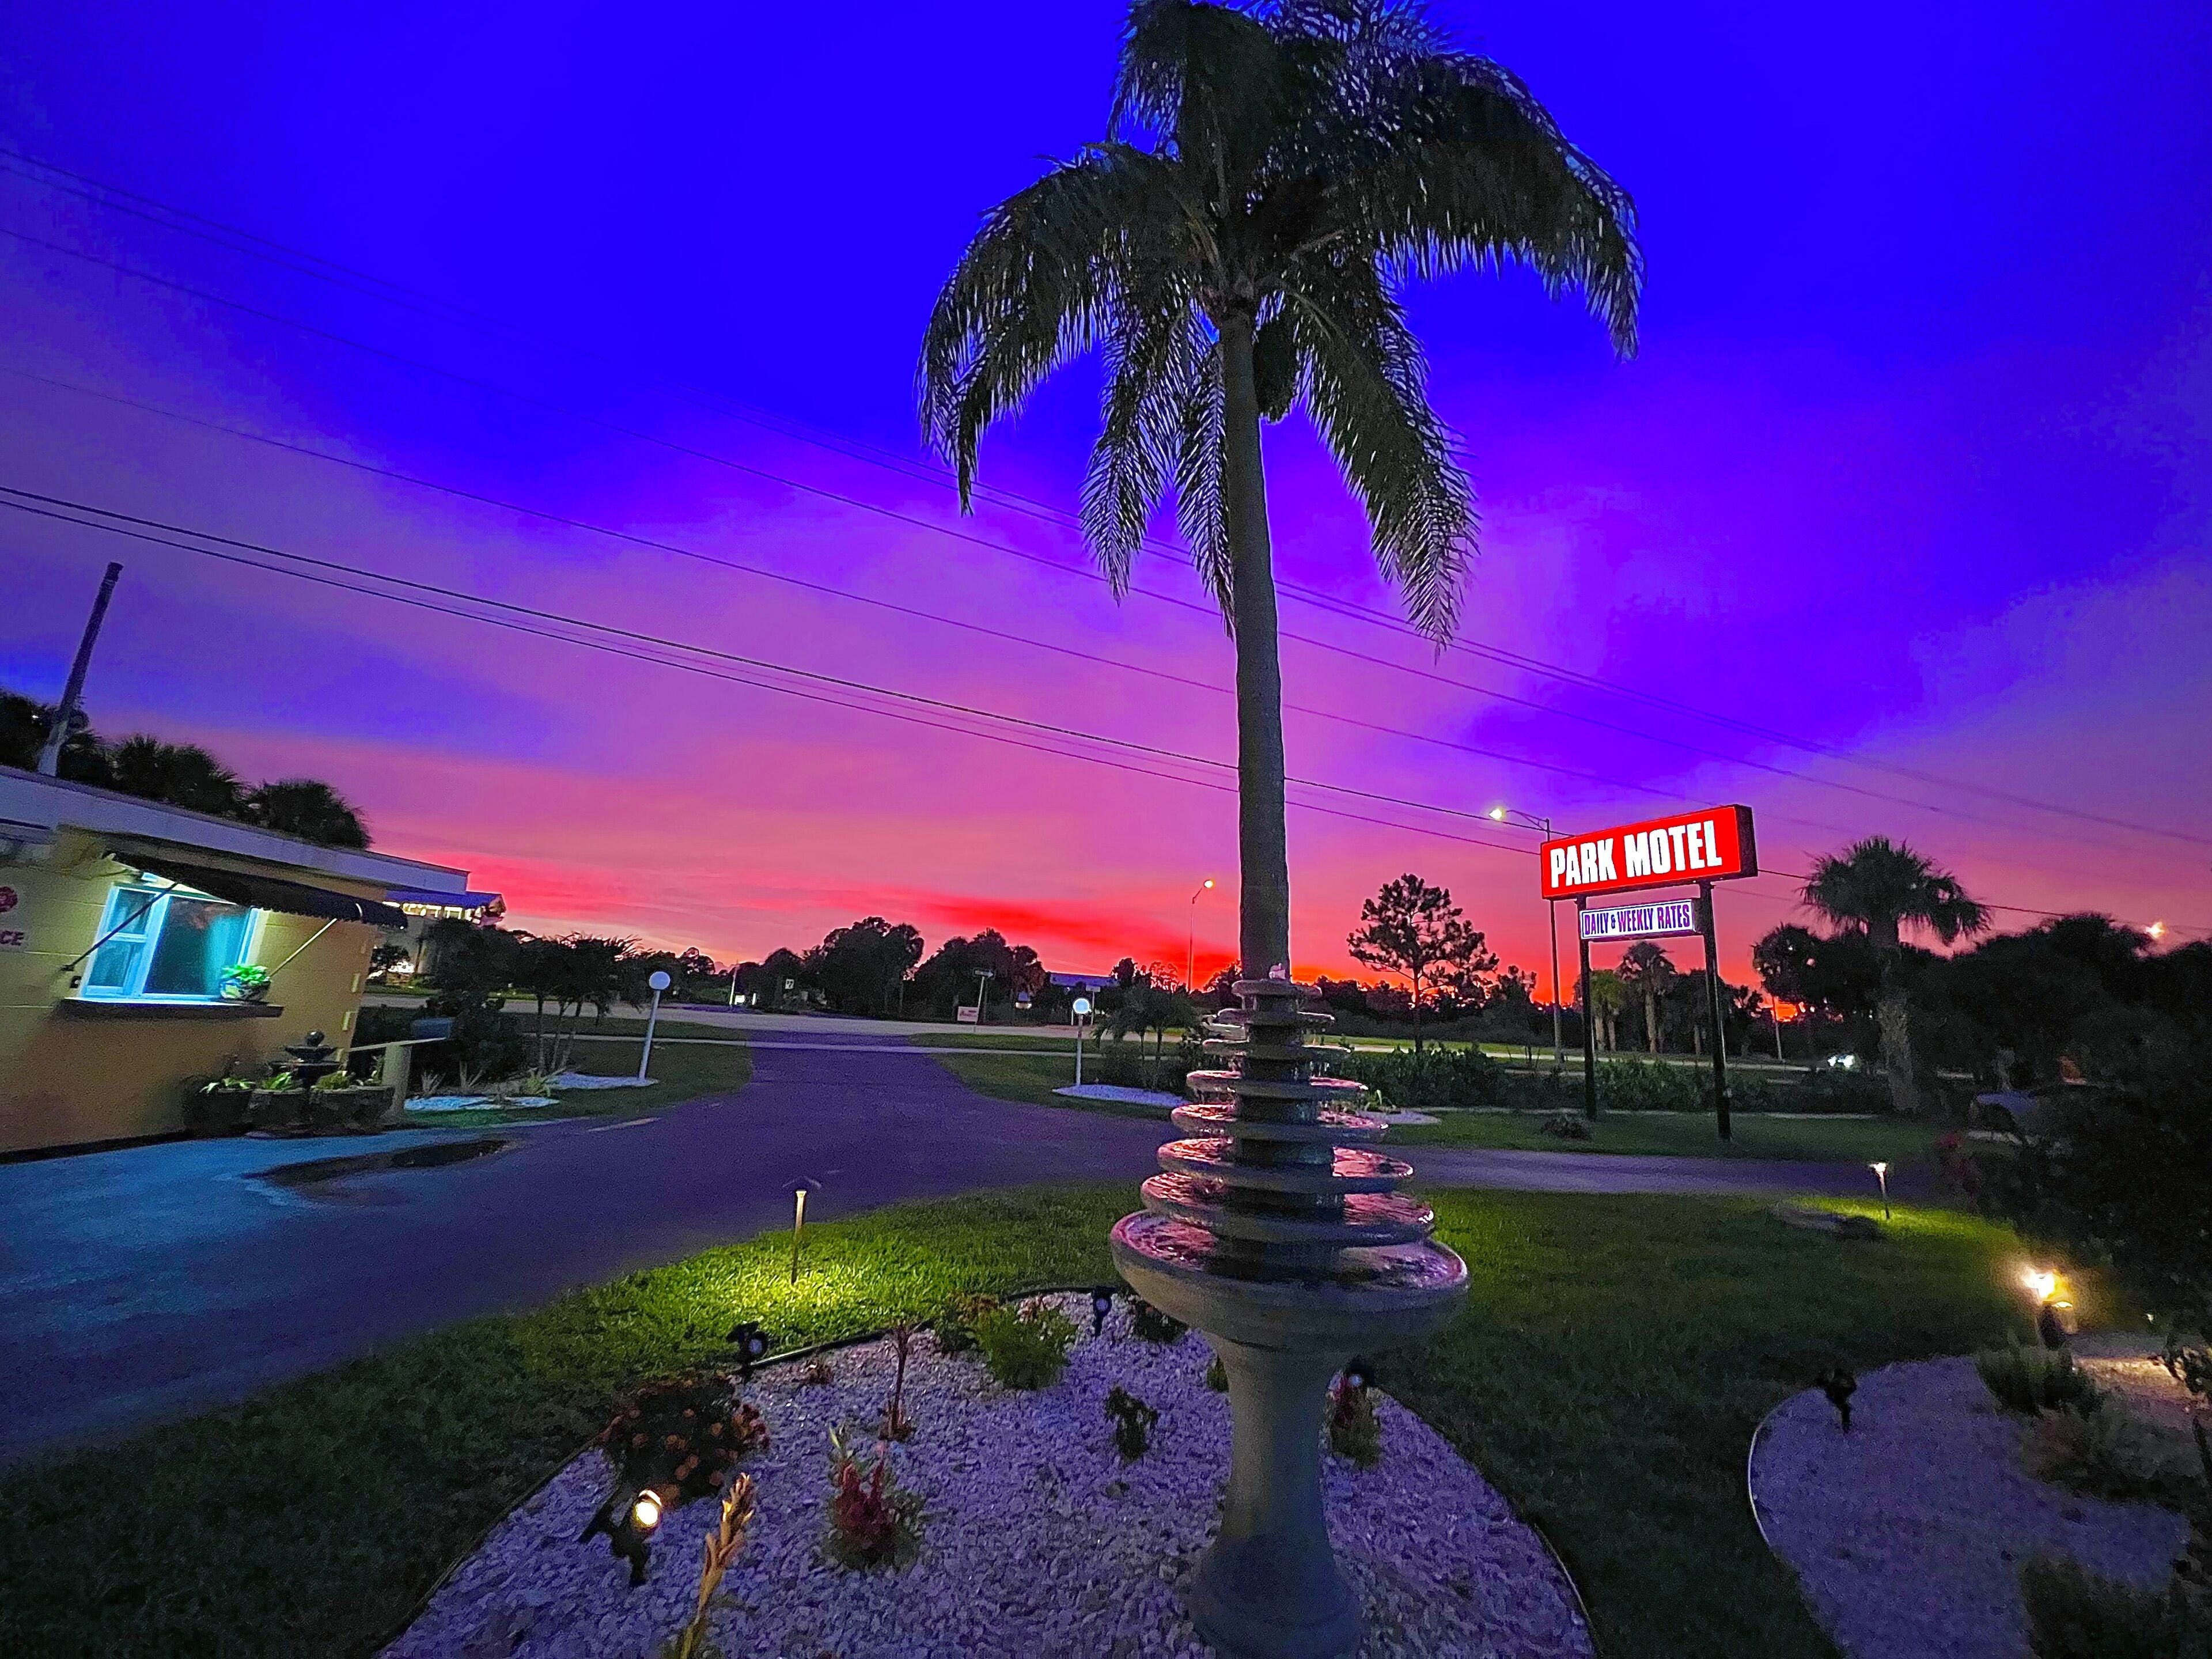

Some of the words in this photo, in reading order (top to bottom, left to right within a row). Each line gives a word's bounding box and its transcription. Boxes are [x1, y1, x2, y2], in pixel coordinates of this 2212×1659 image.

[1550, 838, 1618, 888] PARK
[1623, 820, 1723, 878] MOTEL
[1584, 912, 1609, 935] DAILY
[1611, 914, 1616, 929] &
[1617, 908, 1654, 933] WEEKLY
[1657, 904, 1690, 929] RATES
